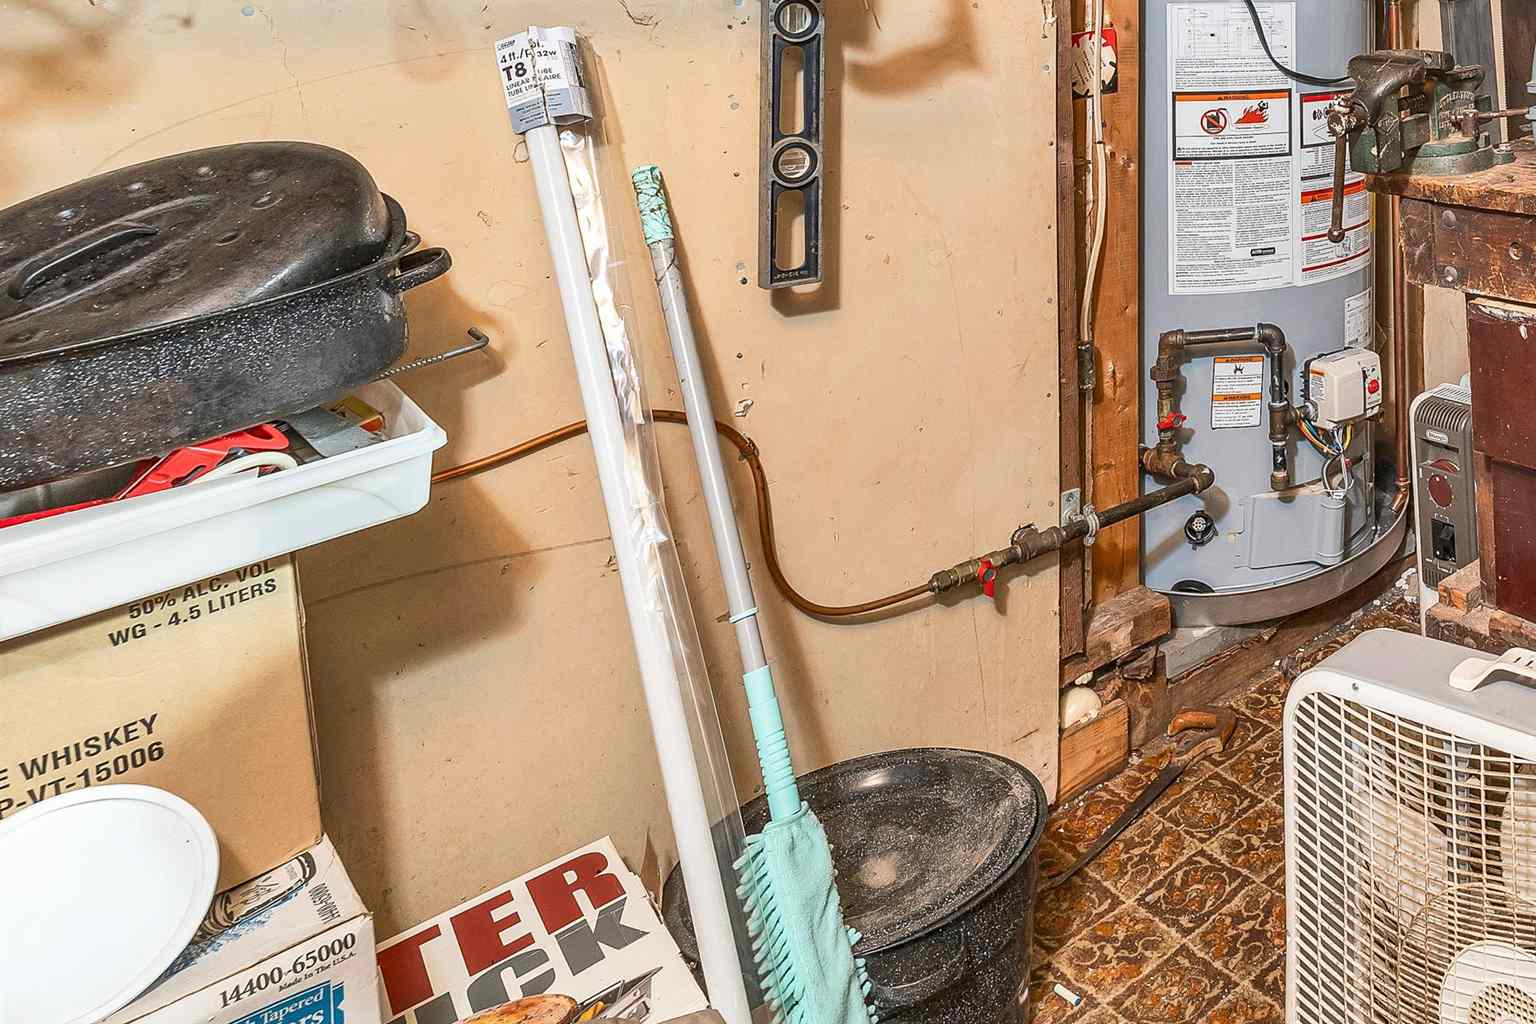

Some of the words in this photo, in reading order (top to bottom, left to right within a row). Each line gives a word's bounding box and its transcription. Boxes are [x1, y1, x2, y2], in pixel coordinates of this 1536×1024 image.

[502, 61, 528, 82] T8
[108, 622, 147, 648] WG
[167, 604, 202, 627] 4.5
[207, 577, 278, 615] LITERS
[127, 593, 177, 620] 50%
[182, 576, 229, 603] ALC.
[236, 560, 276, 584] VOL
[18, 713, 159, 782] WHISKEY
[0, 740, 166, 821] P-VT-15006
[219, 932, 357, 1009] 14400-65000
[278, 978, 301, 992] Made
[315, 964, 332, 975] The
[332, 951, 358, 966] U.S.A.
[258, 987, 325, 1024] Tapered
